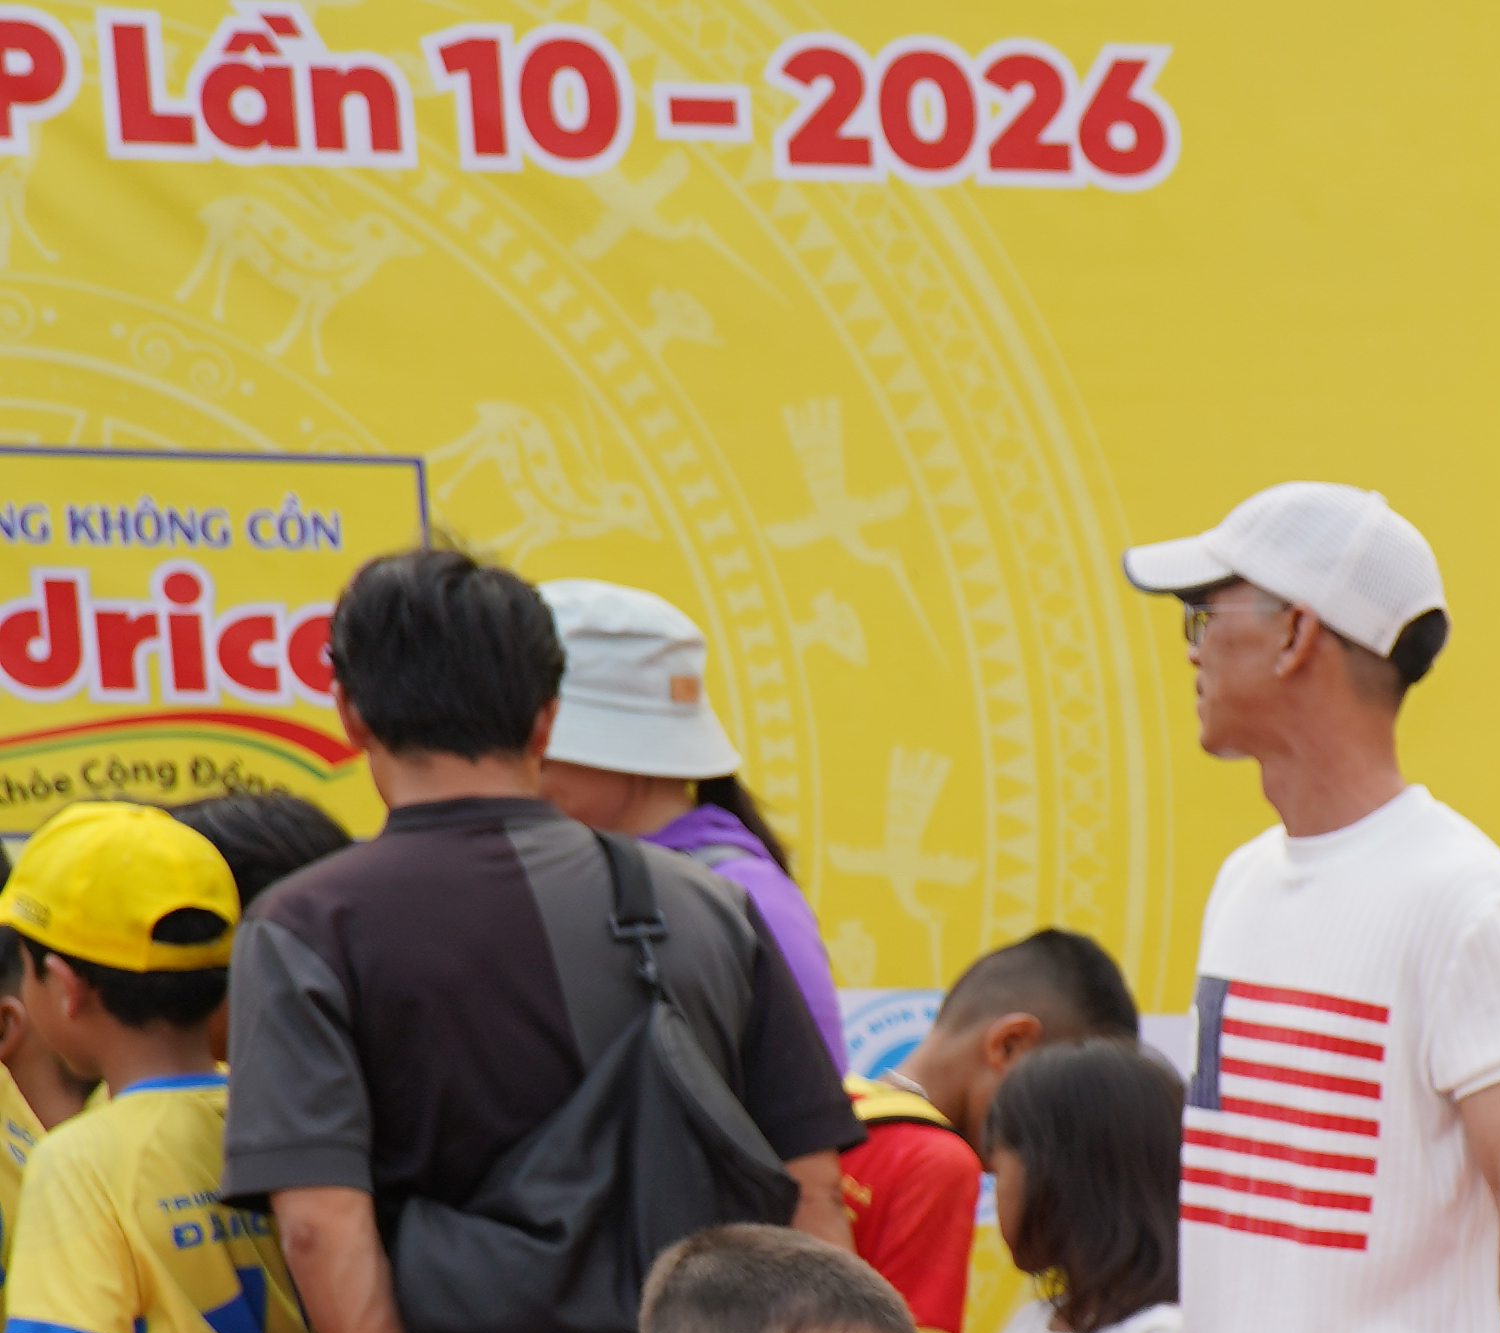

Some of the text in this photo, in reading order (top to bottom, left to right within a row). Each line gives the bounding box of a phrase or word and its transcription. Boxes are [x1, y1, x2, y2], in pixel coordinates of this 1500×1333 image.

[107, 12, 405, 155] Lần
[439, 36, 620, 163] 10
[779, 45, 1167, 178] 2026
[67, 494, 231, 549] KHÔNG
[247, 491, 342, 551] CỒN
[81, 755, 178, 792] Cộng
